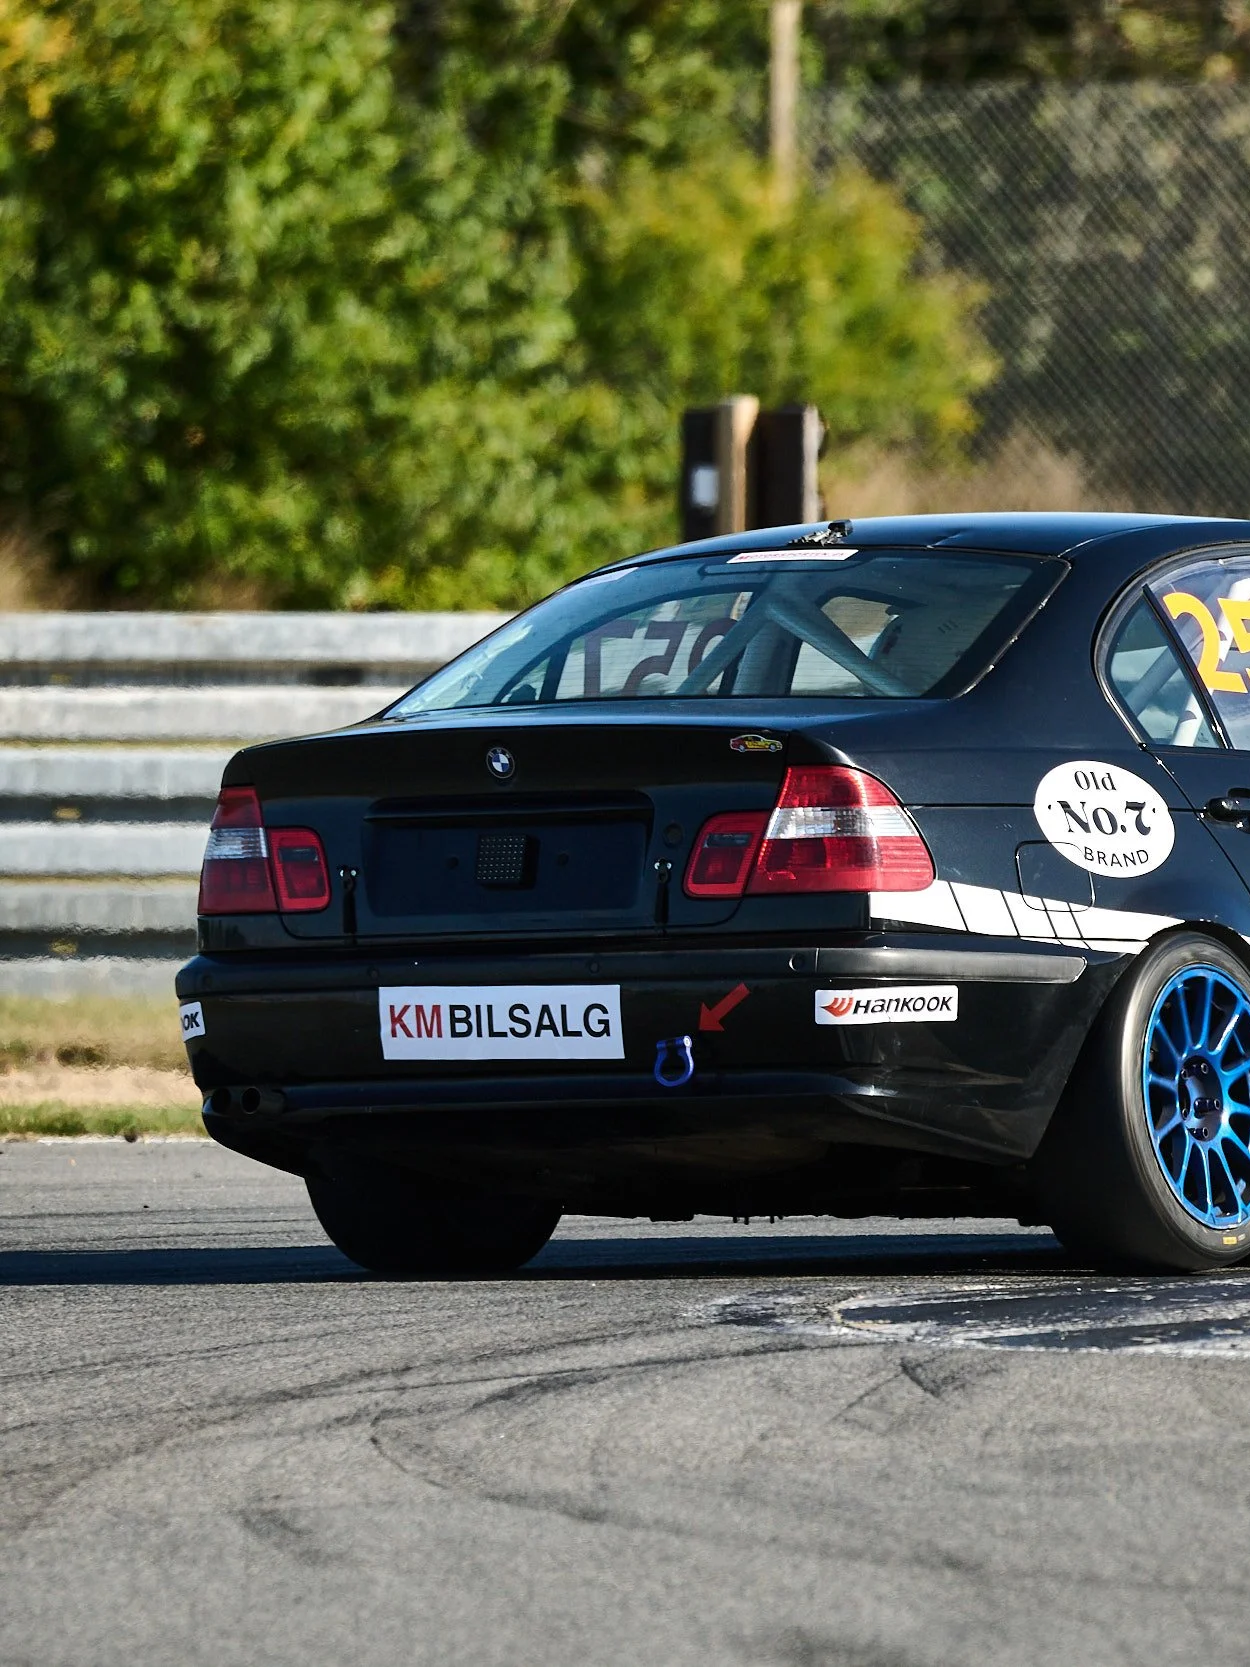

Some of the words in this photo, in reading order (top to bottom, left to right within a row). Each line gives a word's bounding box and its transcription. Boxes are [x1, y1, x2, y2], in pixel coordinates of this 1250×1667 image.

[1074, 770, 1117, 791] Old
[1083, 846, 1150, 868] BRAND
[180, 1011, 201, 1031] OK
